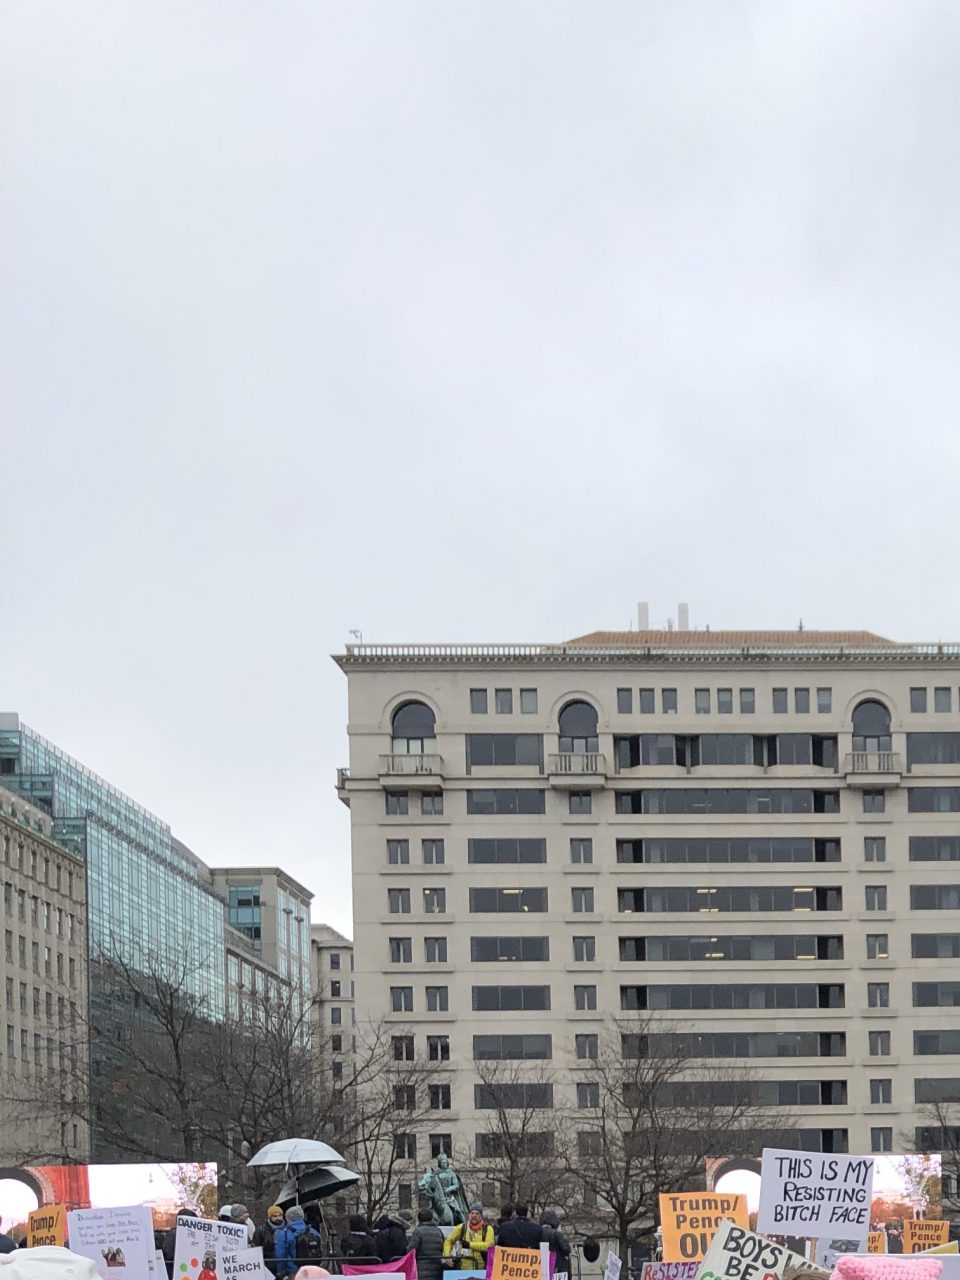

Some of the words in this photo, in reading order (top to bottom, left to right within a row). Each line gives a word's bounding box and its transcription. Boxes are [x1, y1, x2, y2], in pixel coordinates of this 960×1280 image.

[775, 1157, 813, 1179] THIS
[820, 1160, 838, 1181] IS
[844, 1159, 874, 1186] MY
[783, 1181, 867, 1203] RESISTING
[669, 1196, 739, 1214] Trump/
[774, 1204, 821, 1222] BITCH
[829, 1206, 868, 1224] FACE
[30, 1210, 60, 1233] Trump/
[177, 1217, 213, 1233] DANGER
[217, 1224, 244, 1239] TOXIC!
[909, 1221, 944, 1232] Trump/
[910, 1231, 942, 1241] Pence
[722, 1227, 783, 1269] BOYS
[222, 1255, 238, 1265] WE
[223, 1262, 260, 1275] MARCH
[501, 1264, 539, 1279] Pence
